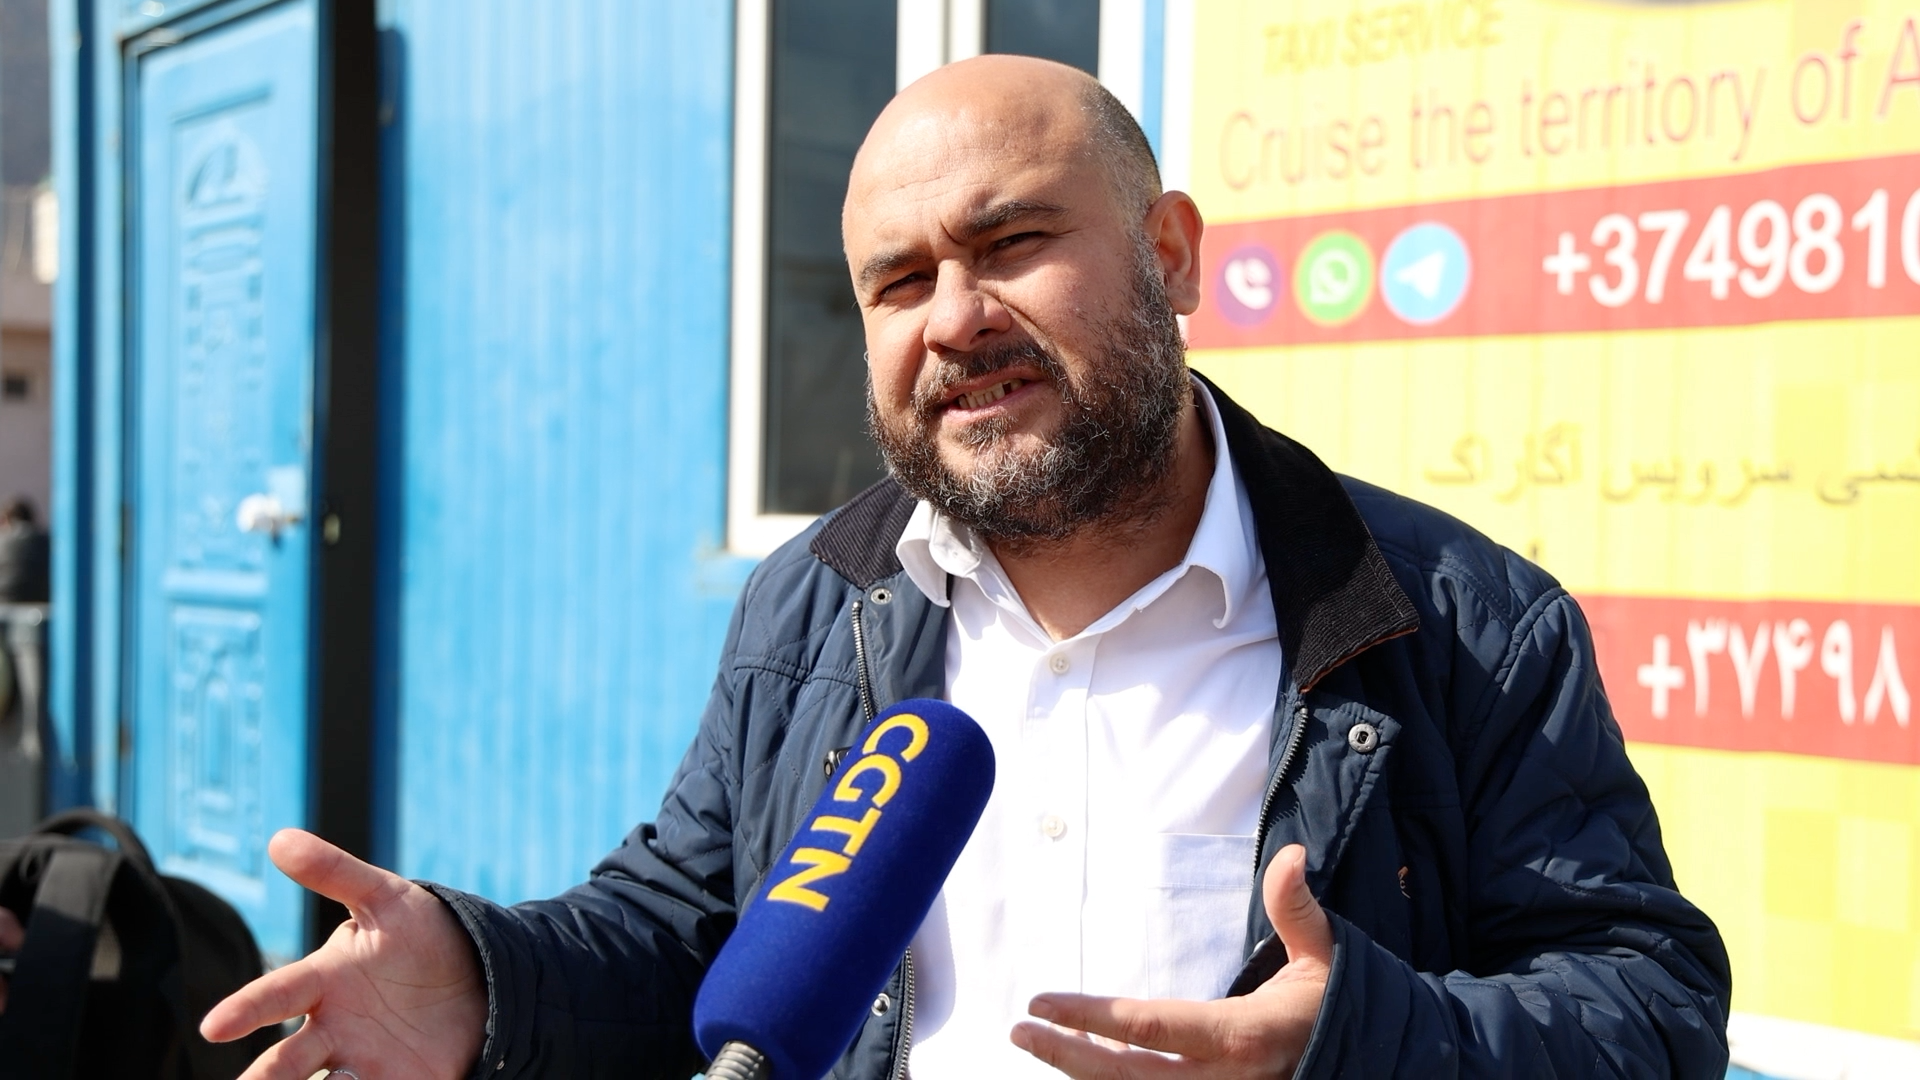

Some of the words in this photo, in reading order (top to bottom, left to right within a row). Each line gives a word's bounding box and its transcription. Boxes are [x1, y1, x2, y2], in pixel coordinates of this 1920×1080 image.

[1219, 101, 1389, 192] Cruise
[1411, 87, 1496, 173] the
[1520, 59, 1767, 162] territory
[1791, 20, 1865, 125] of
[1341, 0, 1505, 67] SERVICE
[767, 713, 930, 912] CGTN
